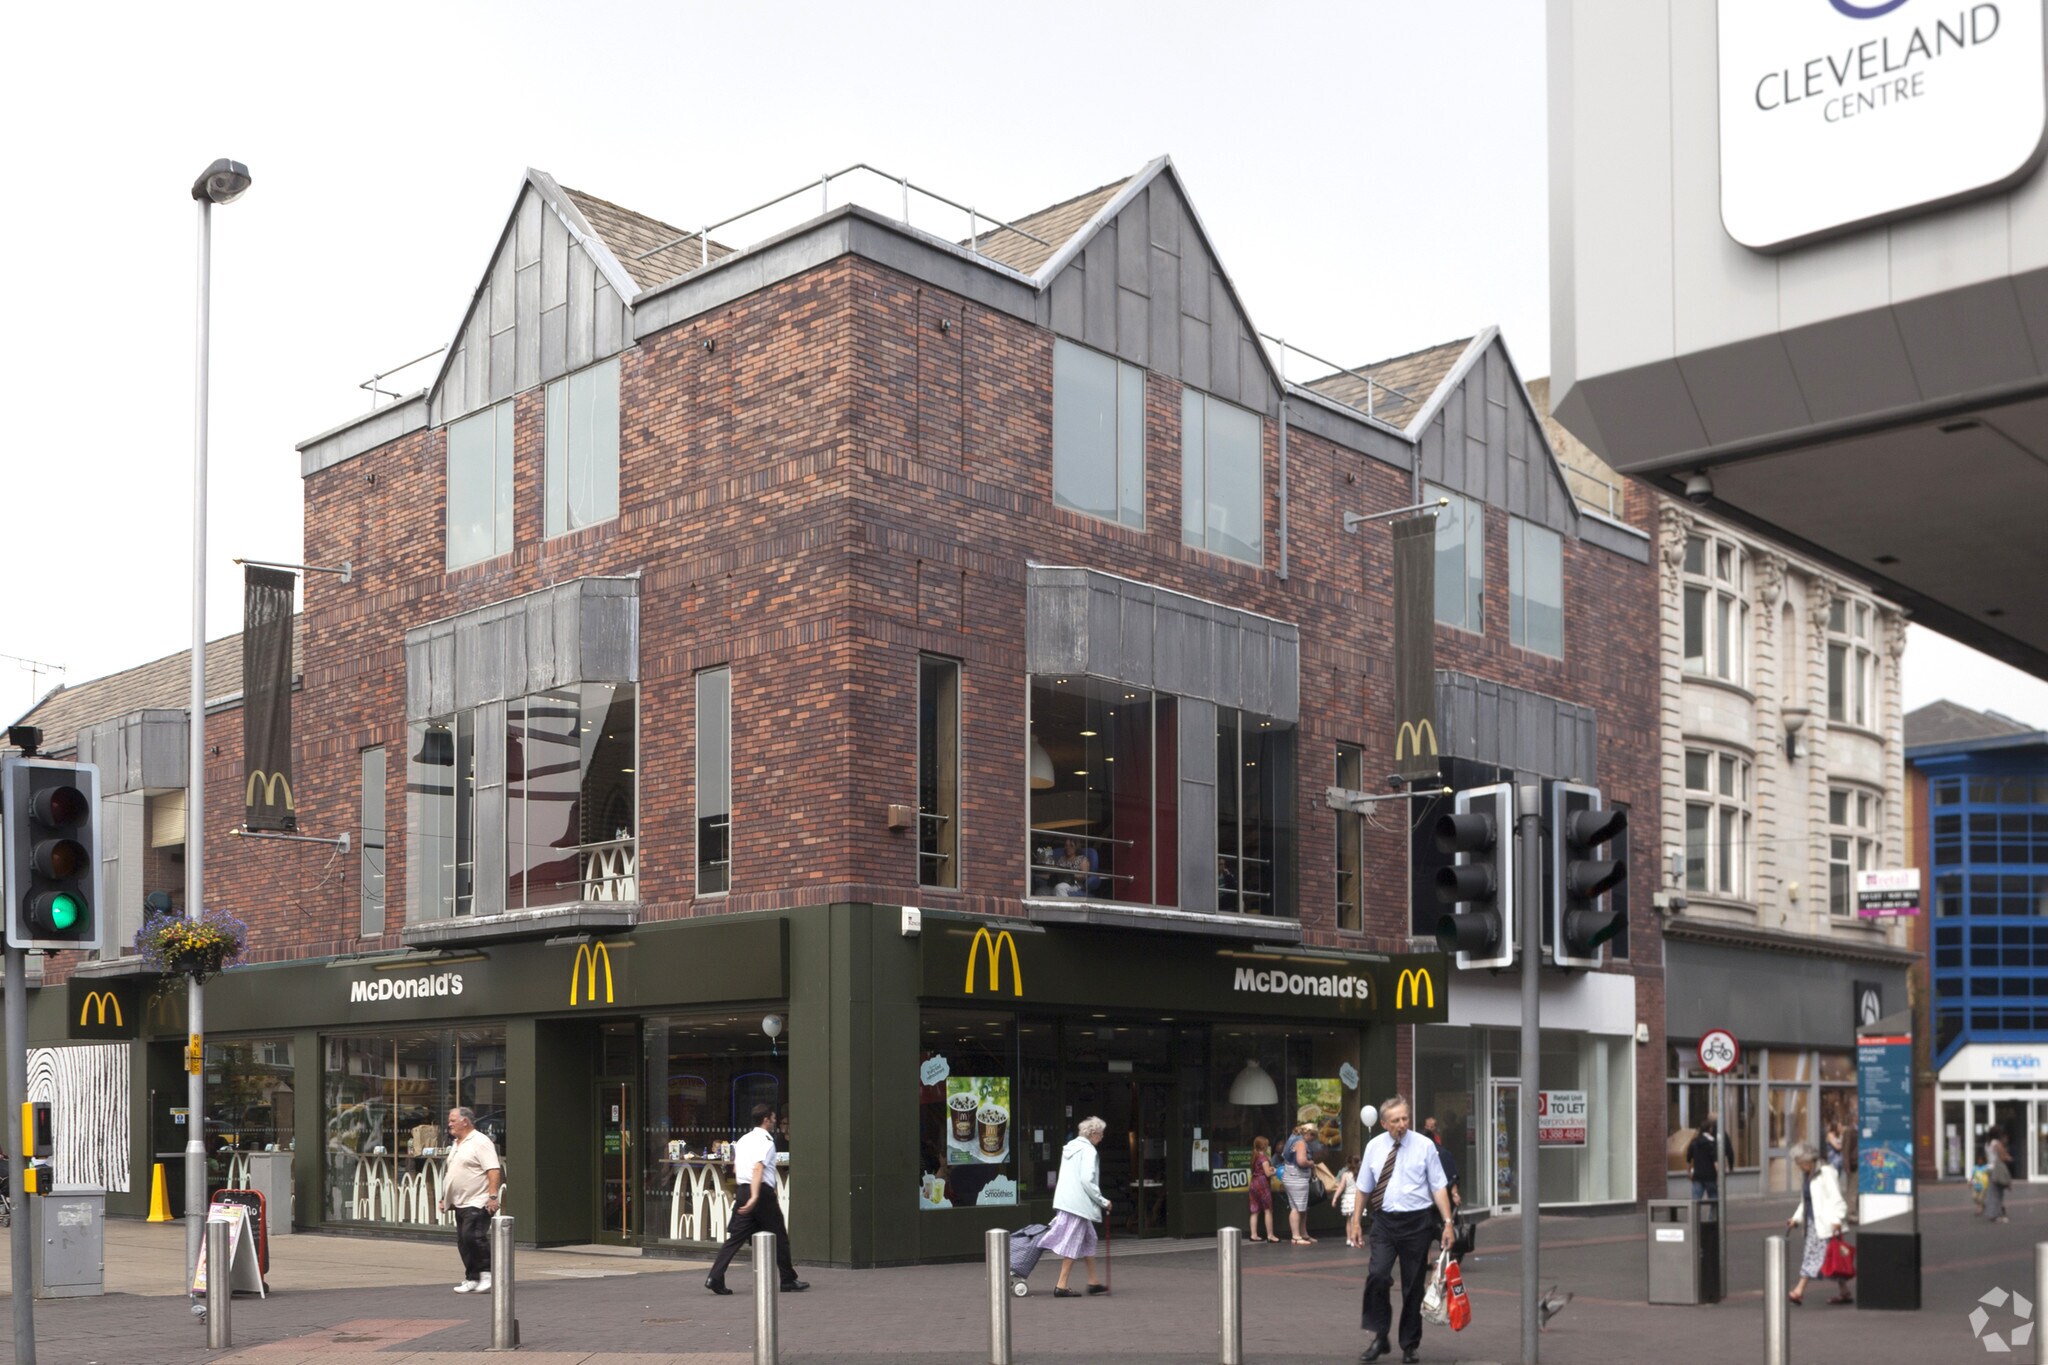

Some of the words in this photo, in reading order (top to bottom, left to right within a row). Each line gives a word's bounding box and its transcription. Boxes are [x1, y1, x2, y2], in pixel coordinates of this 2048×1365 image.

[1755, 3, 2000, 111] CLEVELAND
[1823, 71, 1925, 123] CENTRE
[350, 972, 464, 1003] McDonald's
[1233, 967, 1369, 1000] McDonald's
[1991, 1053, 2041, 1070] maplin
[1551, 1103, 1565, 1114] TO
[1567, 1103, 1585, 1114] LET
[1230, 1171, 1248, 1187] 00
[984, 1190, 1014, 1199] Smoothies
